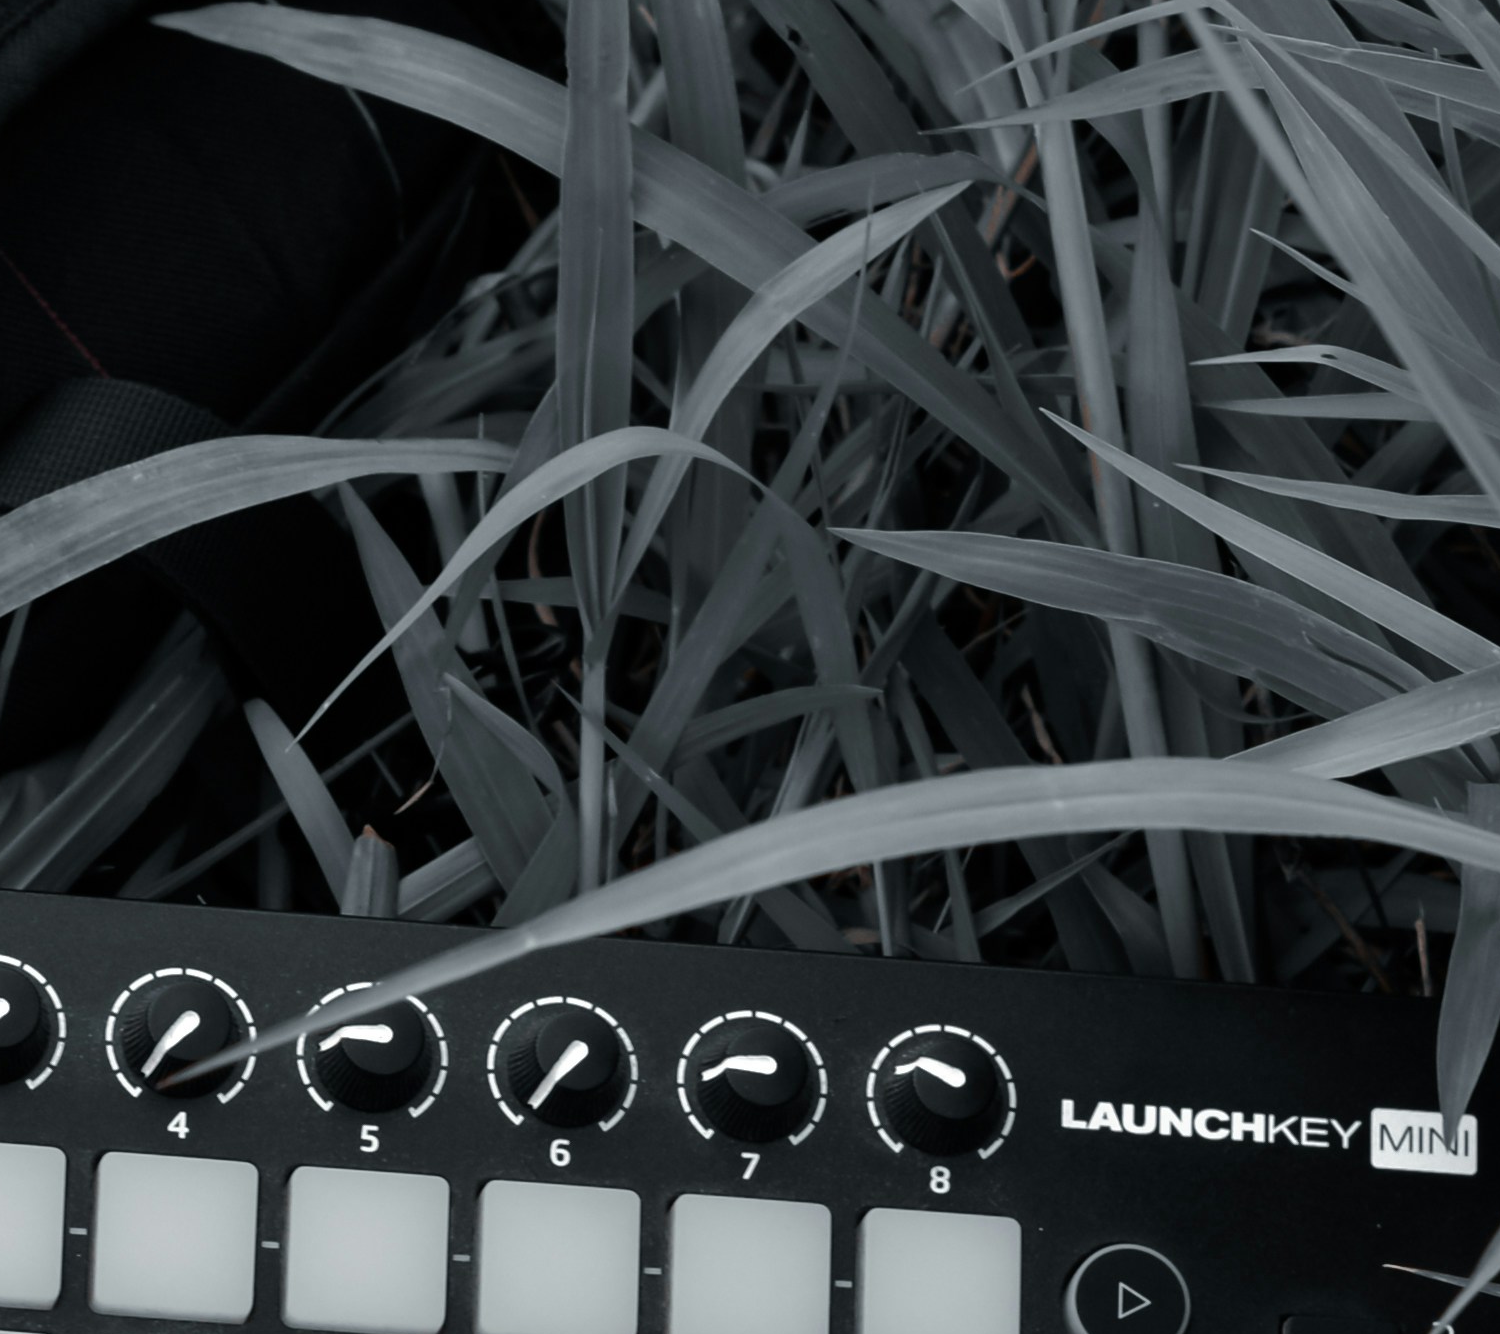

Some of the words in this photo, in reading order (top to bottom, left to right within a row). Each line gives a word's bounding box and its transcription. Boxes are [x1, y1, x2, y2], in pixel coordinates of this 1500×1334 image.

[166, 1111, 190, 1139] 4
[359, 1124, 380, 1153] 5
[1061, 1098, 1362, 1149] LAUNCHKEY
[1379, 1122, 1469, 1157] MINI
[549, 1138, 571, 1167] 6
[740, 1152, 761, 1180] 7
[929, 1165, 951, 1194] 8
